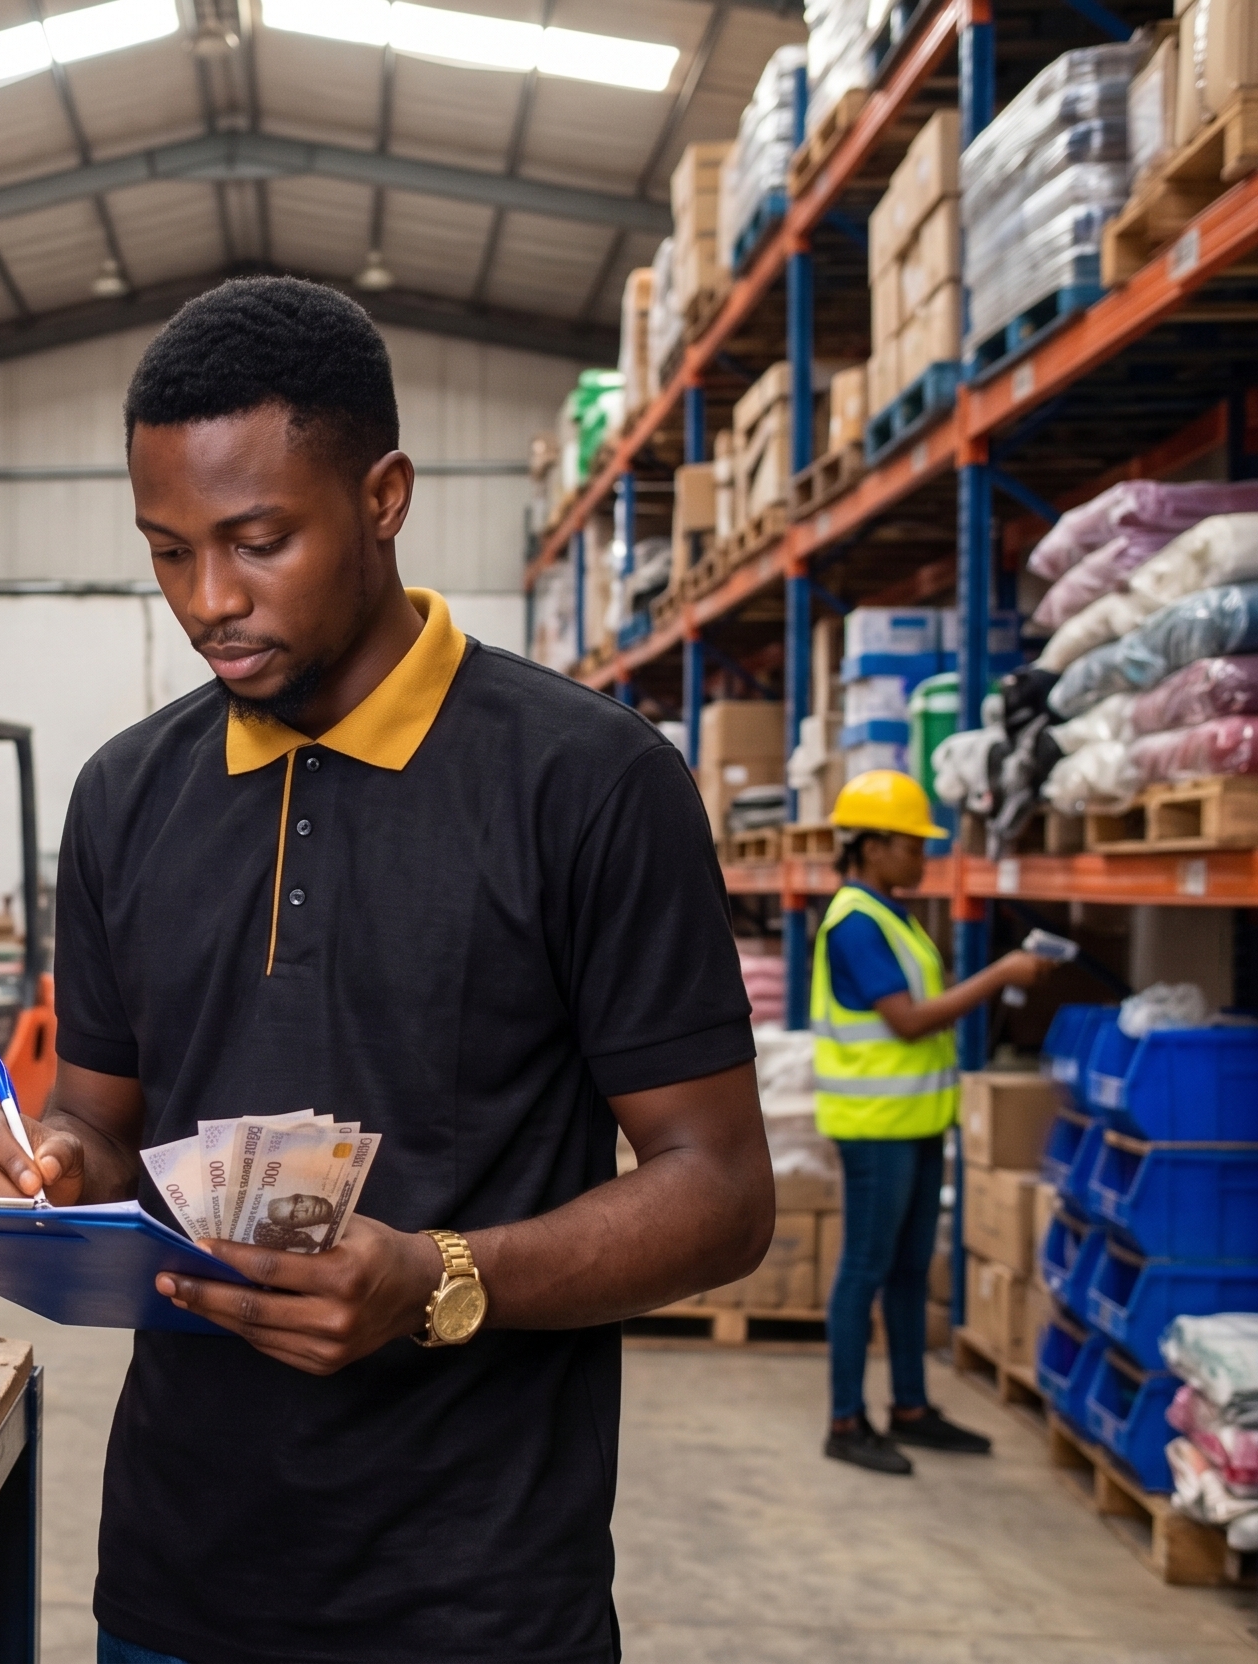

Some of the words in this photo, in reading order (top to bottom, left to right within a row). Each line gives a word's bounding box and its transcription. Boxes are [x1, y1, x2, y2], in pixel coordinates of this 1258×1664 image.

[209, 1161, 226, 1188] 1000
[261, 1161, 281, 1189] 1000
[166, 1184, 190, 1210] 1000
